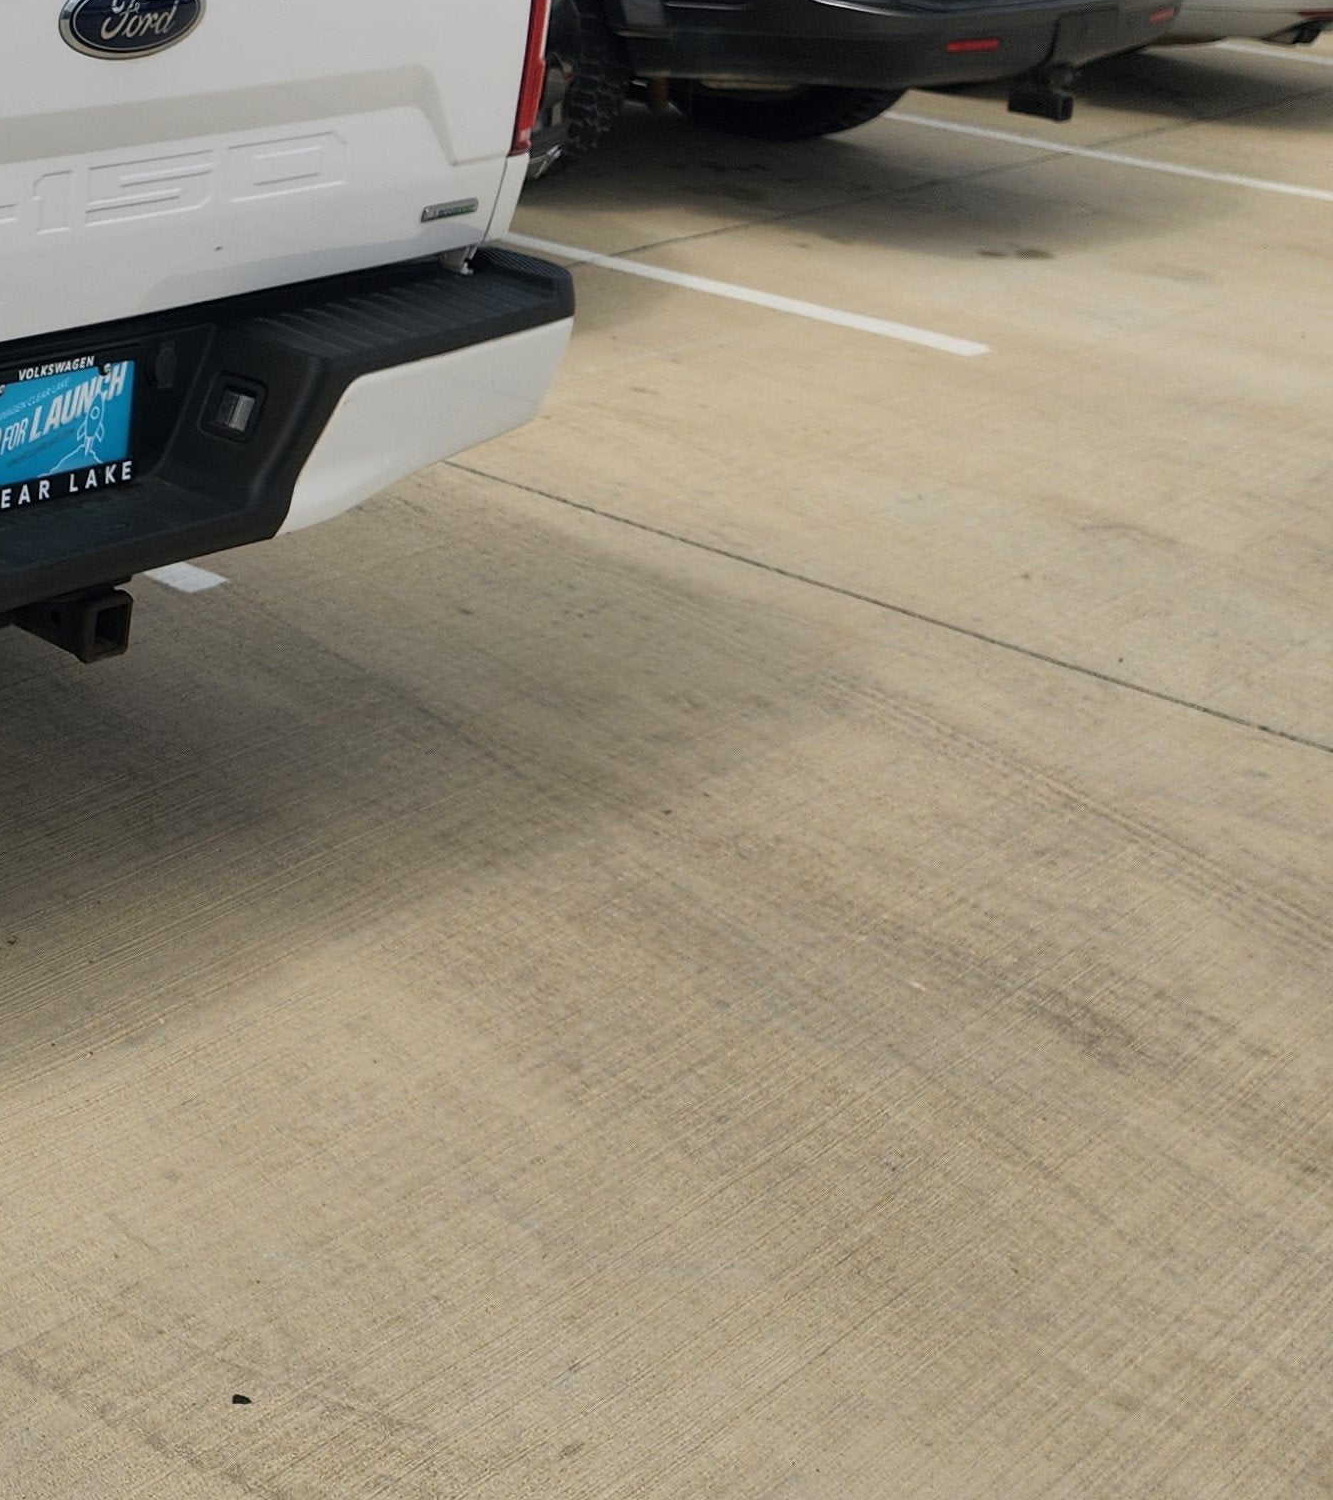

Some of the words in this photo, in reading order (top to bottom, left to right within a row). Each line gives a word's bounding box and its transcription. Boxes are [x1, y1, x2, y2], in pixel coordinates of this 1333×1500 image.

[18, 355, 95, 382] VOLKSWAGEN
[0, 417, 29, 455] FOR
[69, 460, 133, 493] LAKE
